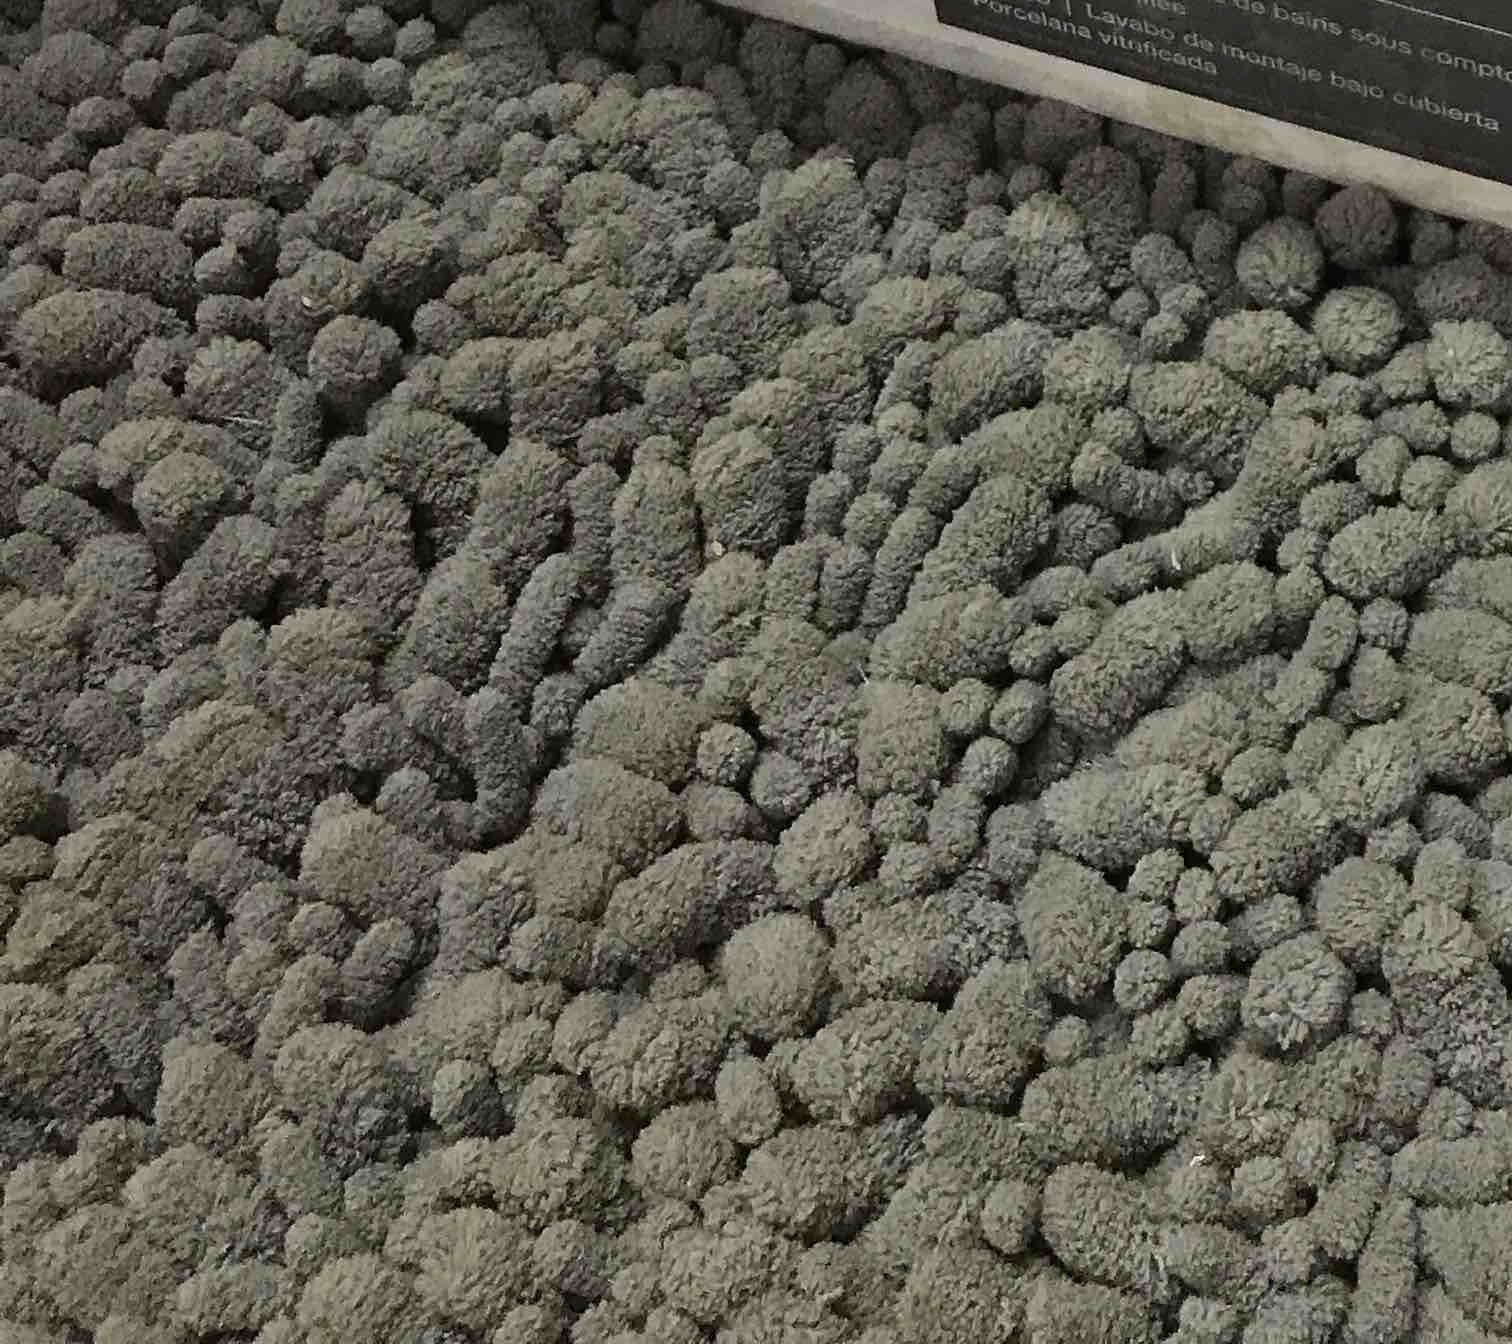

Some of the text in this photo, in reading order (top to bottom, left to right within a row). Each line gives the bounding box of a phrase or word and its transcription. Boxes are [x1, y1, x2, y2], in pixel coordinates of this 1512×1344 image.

[1086, 2, 1176, 41] Lavabo
[1184, 31, 1214, 52] de
[1330, 71, 1386, 99] bajo
[1393, 93, 1499, 132] cubierta
[1274, 2, 1342, 36] bains
[1351, 27, 1412, 55] sous
